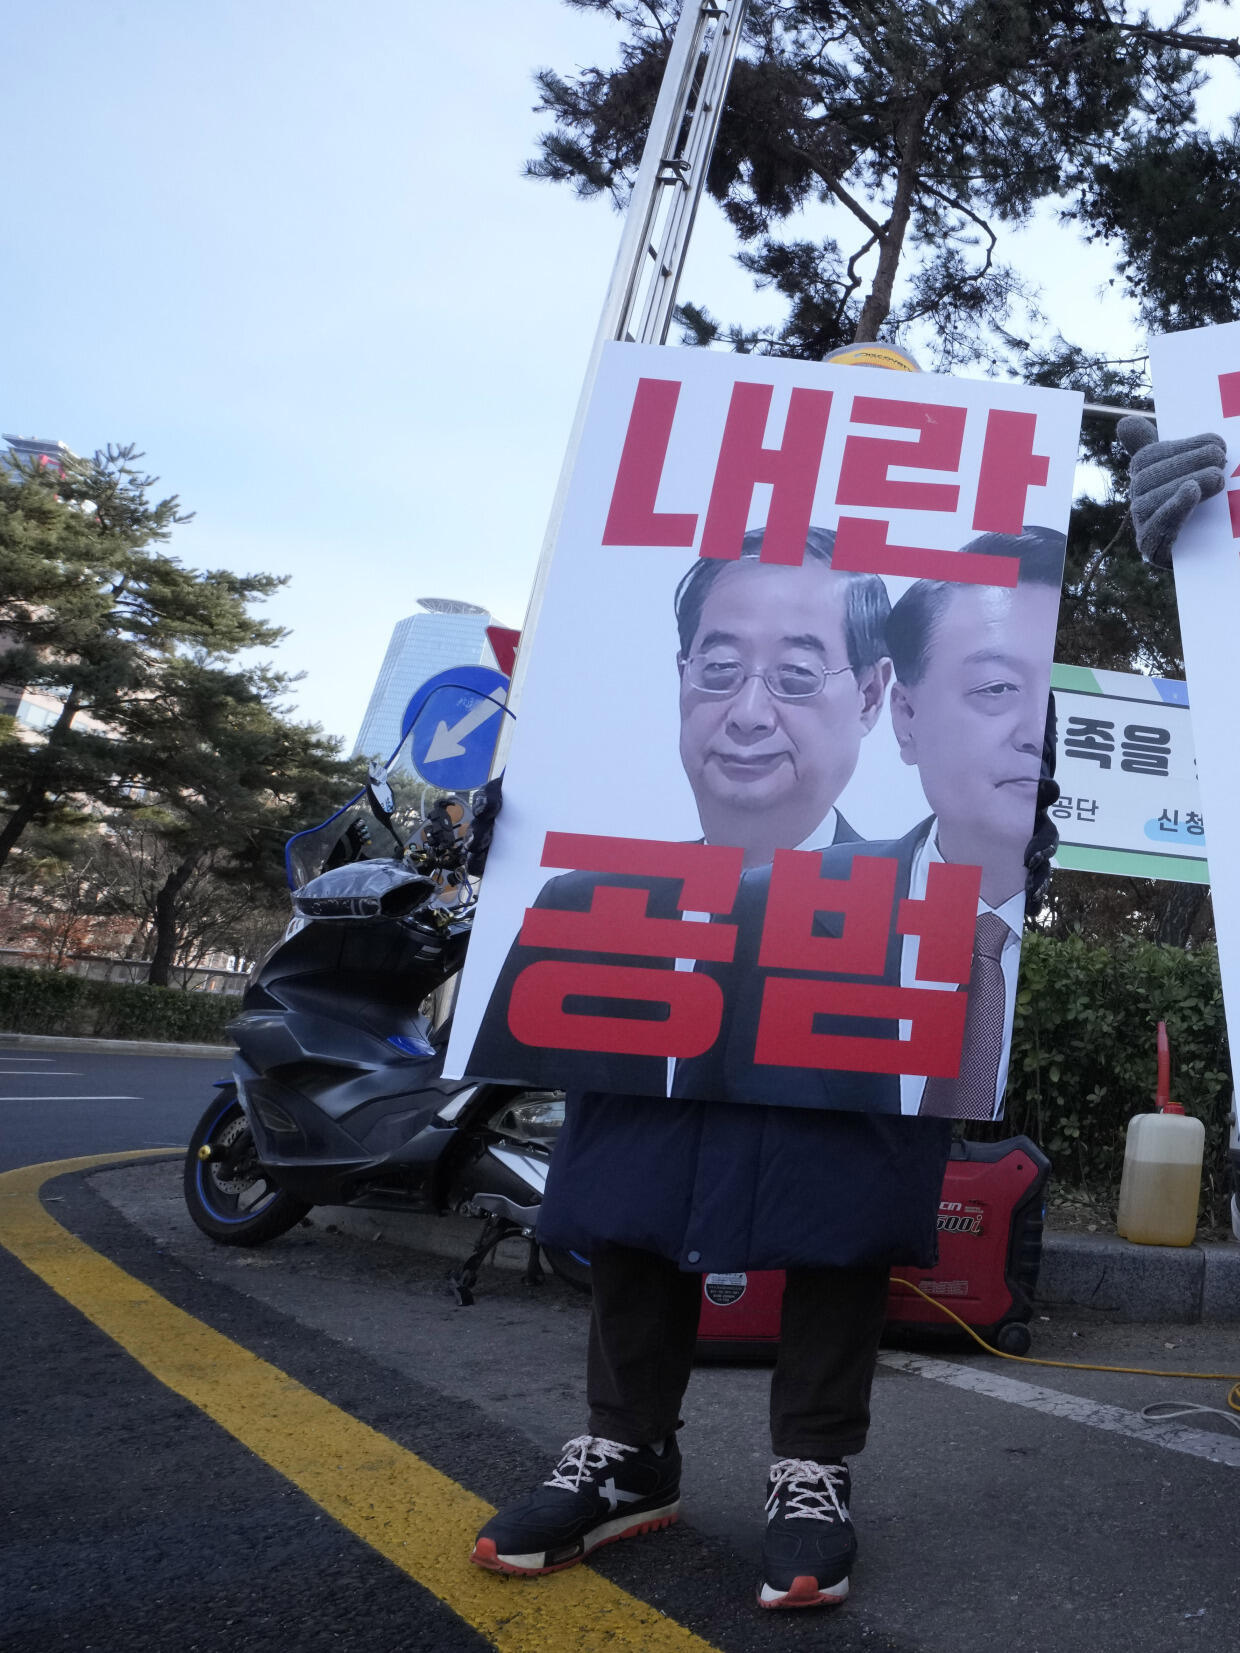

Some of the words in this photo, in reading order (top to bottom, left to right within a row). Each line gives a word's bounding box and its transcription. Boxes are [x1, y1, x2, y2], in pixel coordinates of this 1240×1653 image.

[601, 378, 1050, 588] 내란
[1055, 716, 1172, 777] 족을
[508, 831, 983, 1079] 공범
